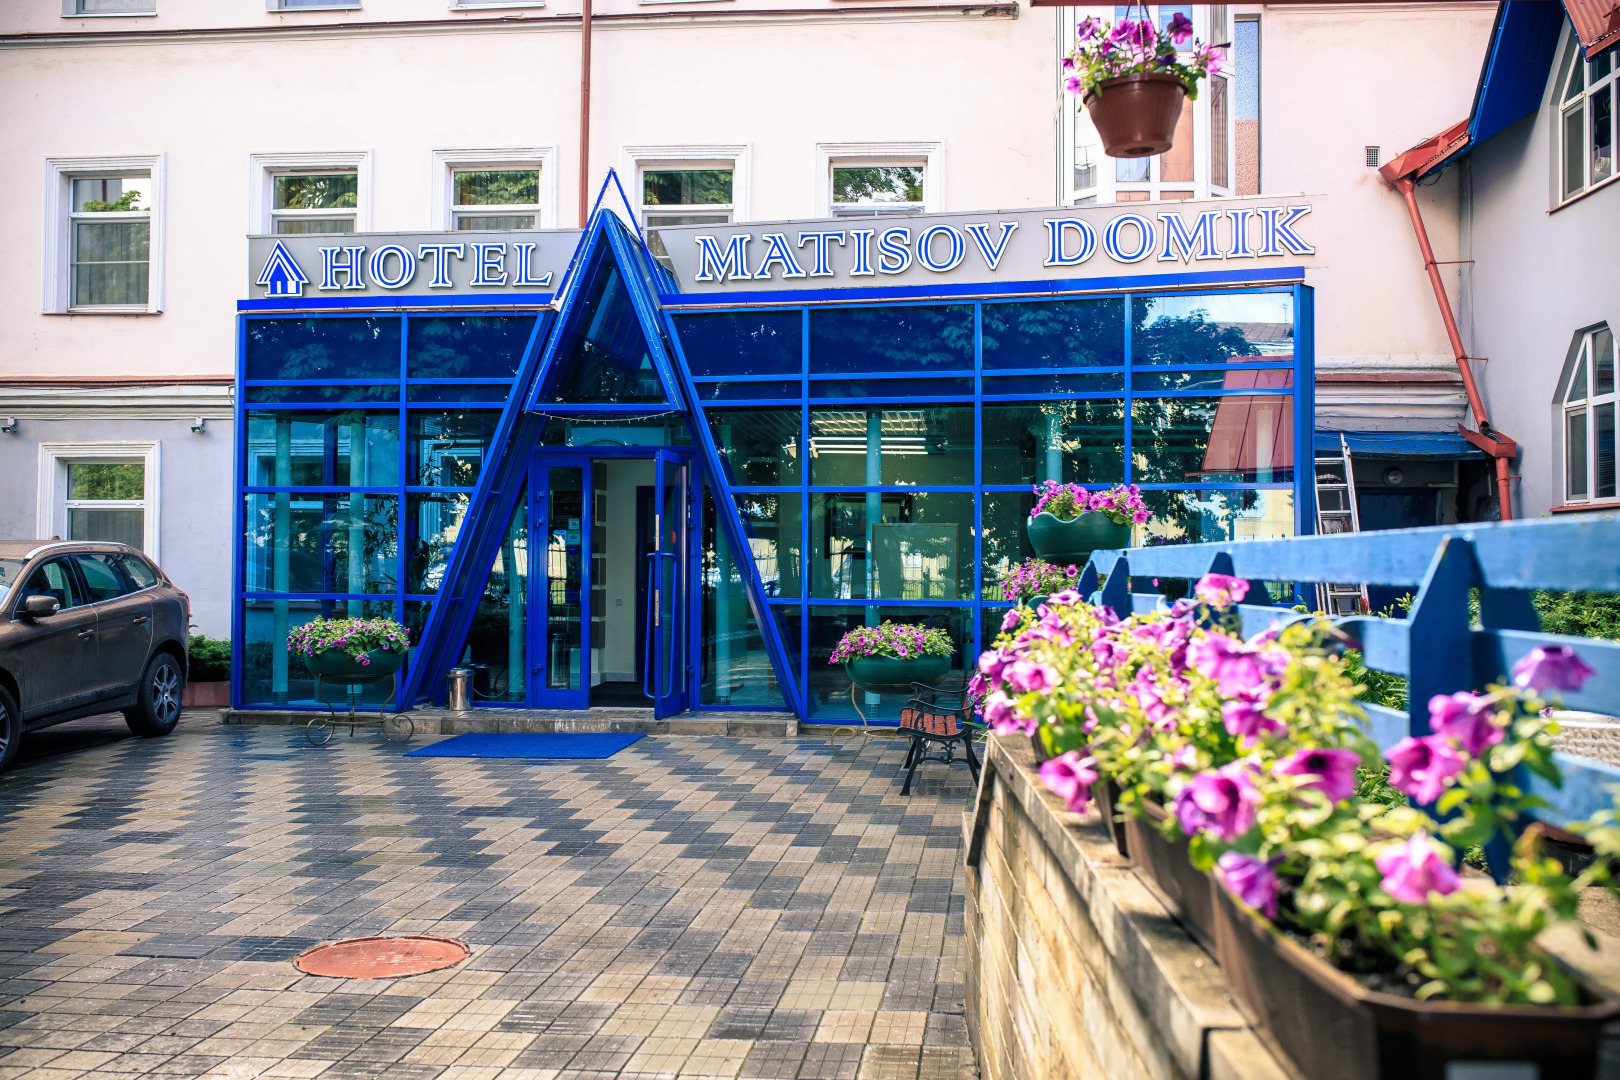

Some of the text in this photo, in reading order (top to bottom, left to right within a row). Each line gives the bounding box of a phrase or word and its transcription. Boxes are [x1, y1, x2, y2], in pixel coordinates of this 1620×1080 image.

[318, 242, 553, 290] HOTEL
[694, 204, 1316, 283] MATISOV DOMIK
